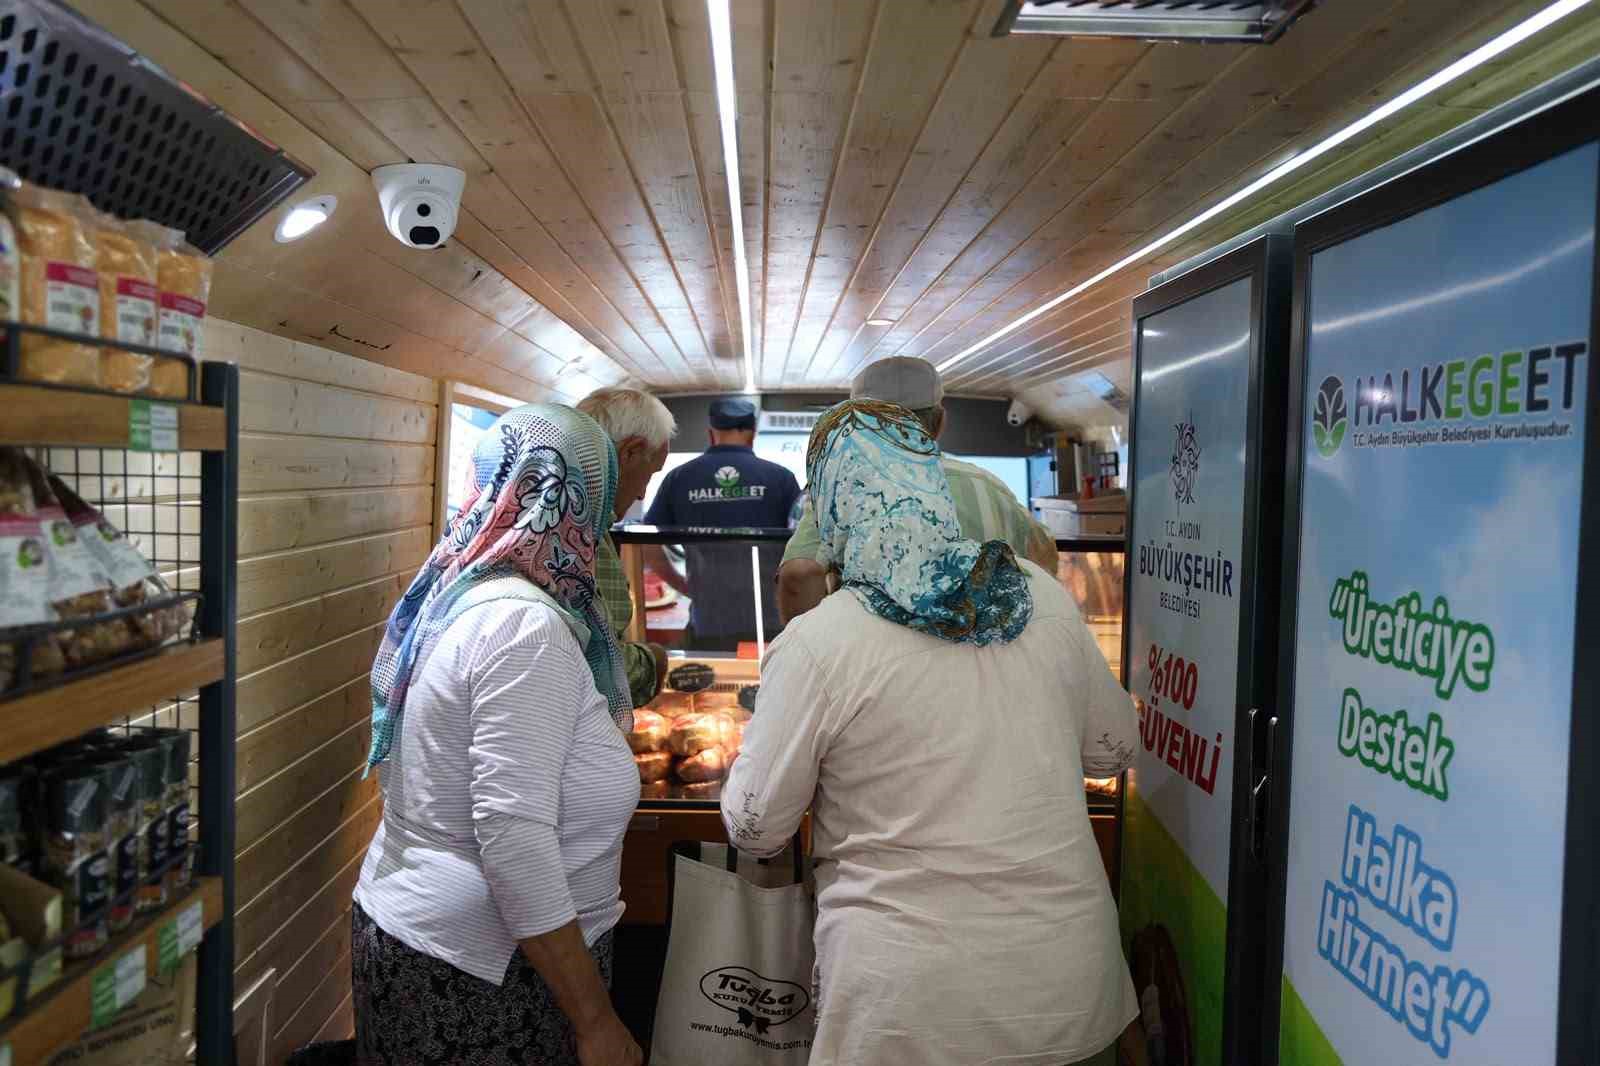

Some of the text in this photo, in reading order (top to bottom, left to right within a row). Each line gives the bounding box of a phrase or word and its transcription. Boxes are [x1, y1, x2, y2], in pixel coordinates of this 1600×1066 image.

[1354, 342, 1587, 427] HALKEGEET
[1442, 424, 1491, 443] Belediyesi
[1494, 421, 1573, 441] Kuruluşudur.
[688, 485, 767, 501] HALKEGEET
[1178, 521, 1201, 541] AYDIN
[1140, 540, 1232, 598] BÜYÜKŞEHİR
[1148, 643, 1198, 711] %100
[1338, 688, 1454, 801] Destek
[1342, 804, 1458, 951] Halka
